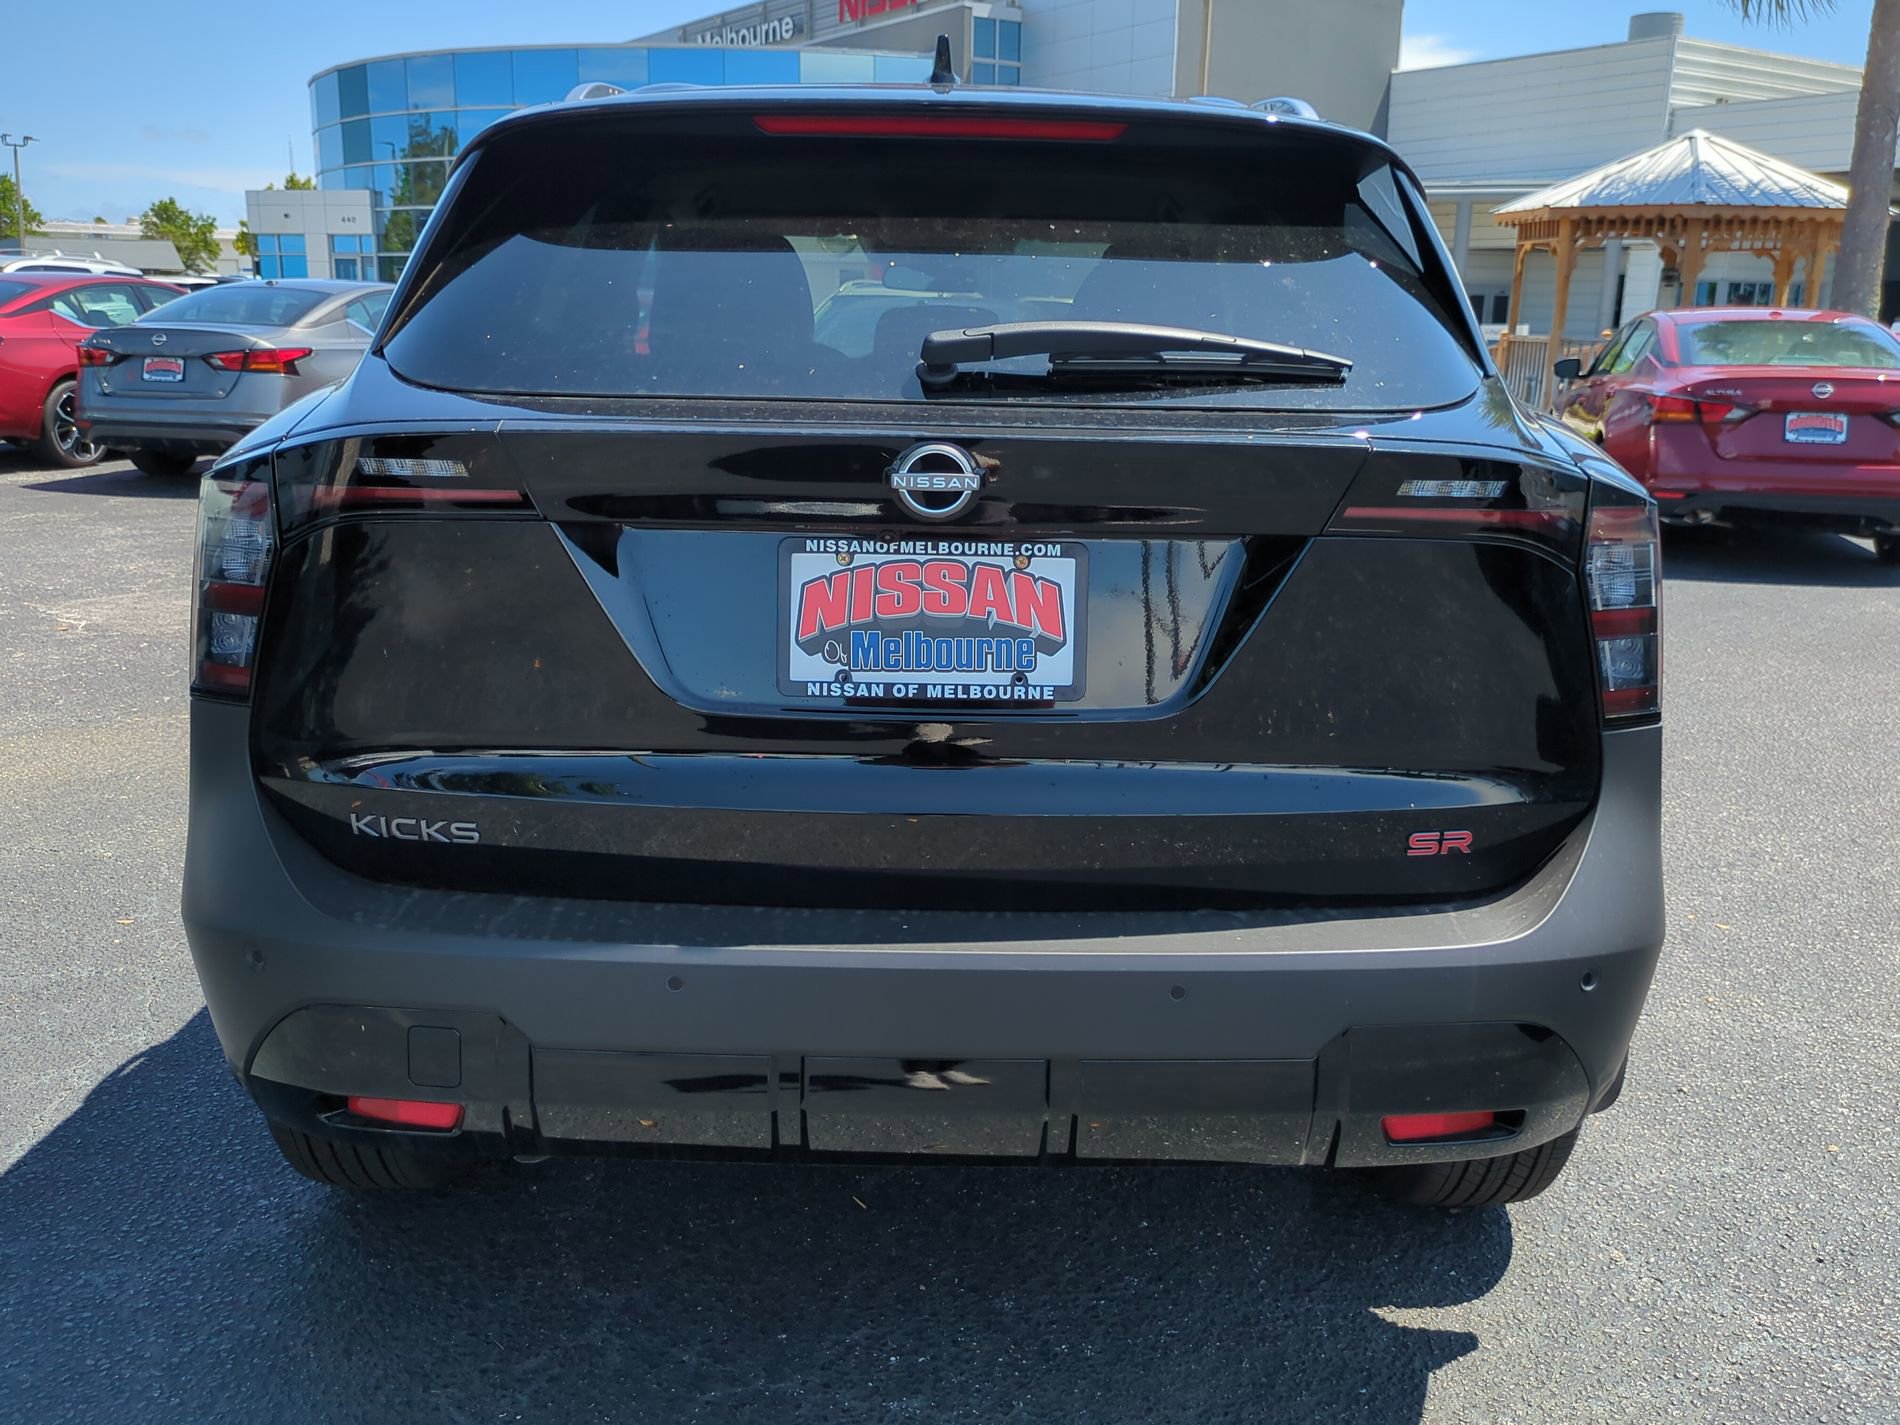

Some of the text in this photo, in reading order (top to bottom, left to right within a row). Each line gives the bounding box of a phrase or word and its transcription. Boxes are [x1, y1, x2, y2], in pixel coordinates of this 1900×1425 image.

[891, 475, 979, 489] NISSAN
[805, 539, 1062, 557] NISSANOFMELBOURNE.COM
[798, 561, 1064, 643] NISSAN
[824, 630, 1035, 671] Of Melbourne
[807, 681, 1055, 700] NISSAN OF MELBOURNE
[350, 813, 481, 844] KICKS
[1407, 830, 1473, 856] SR
